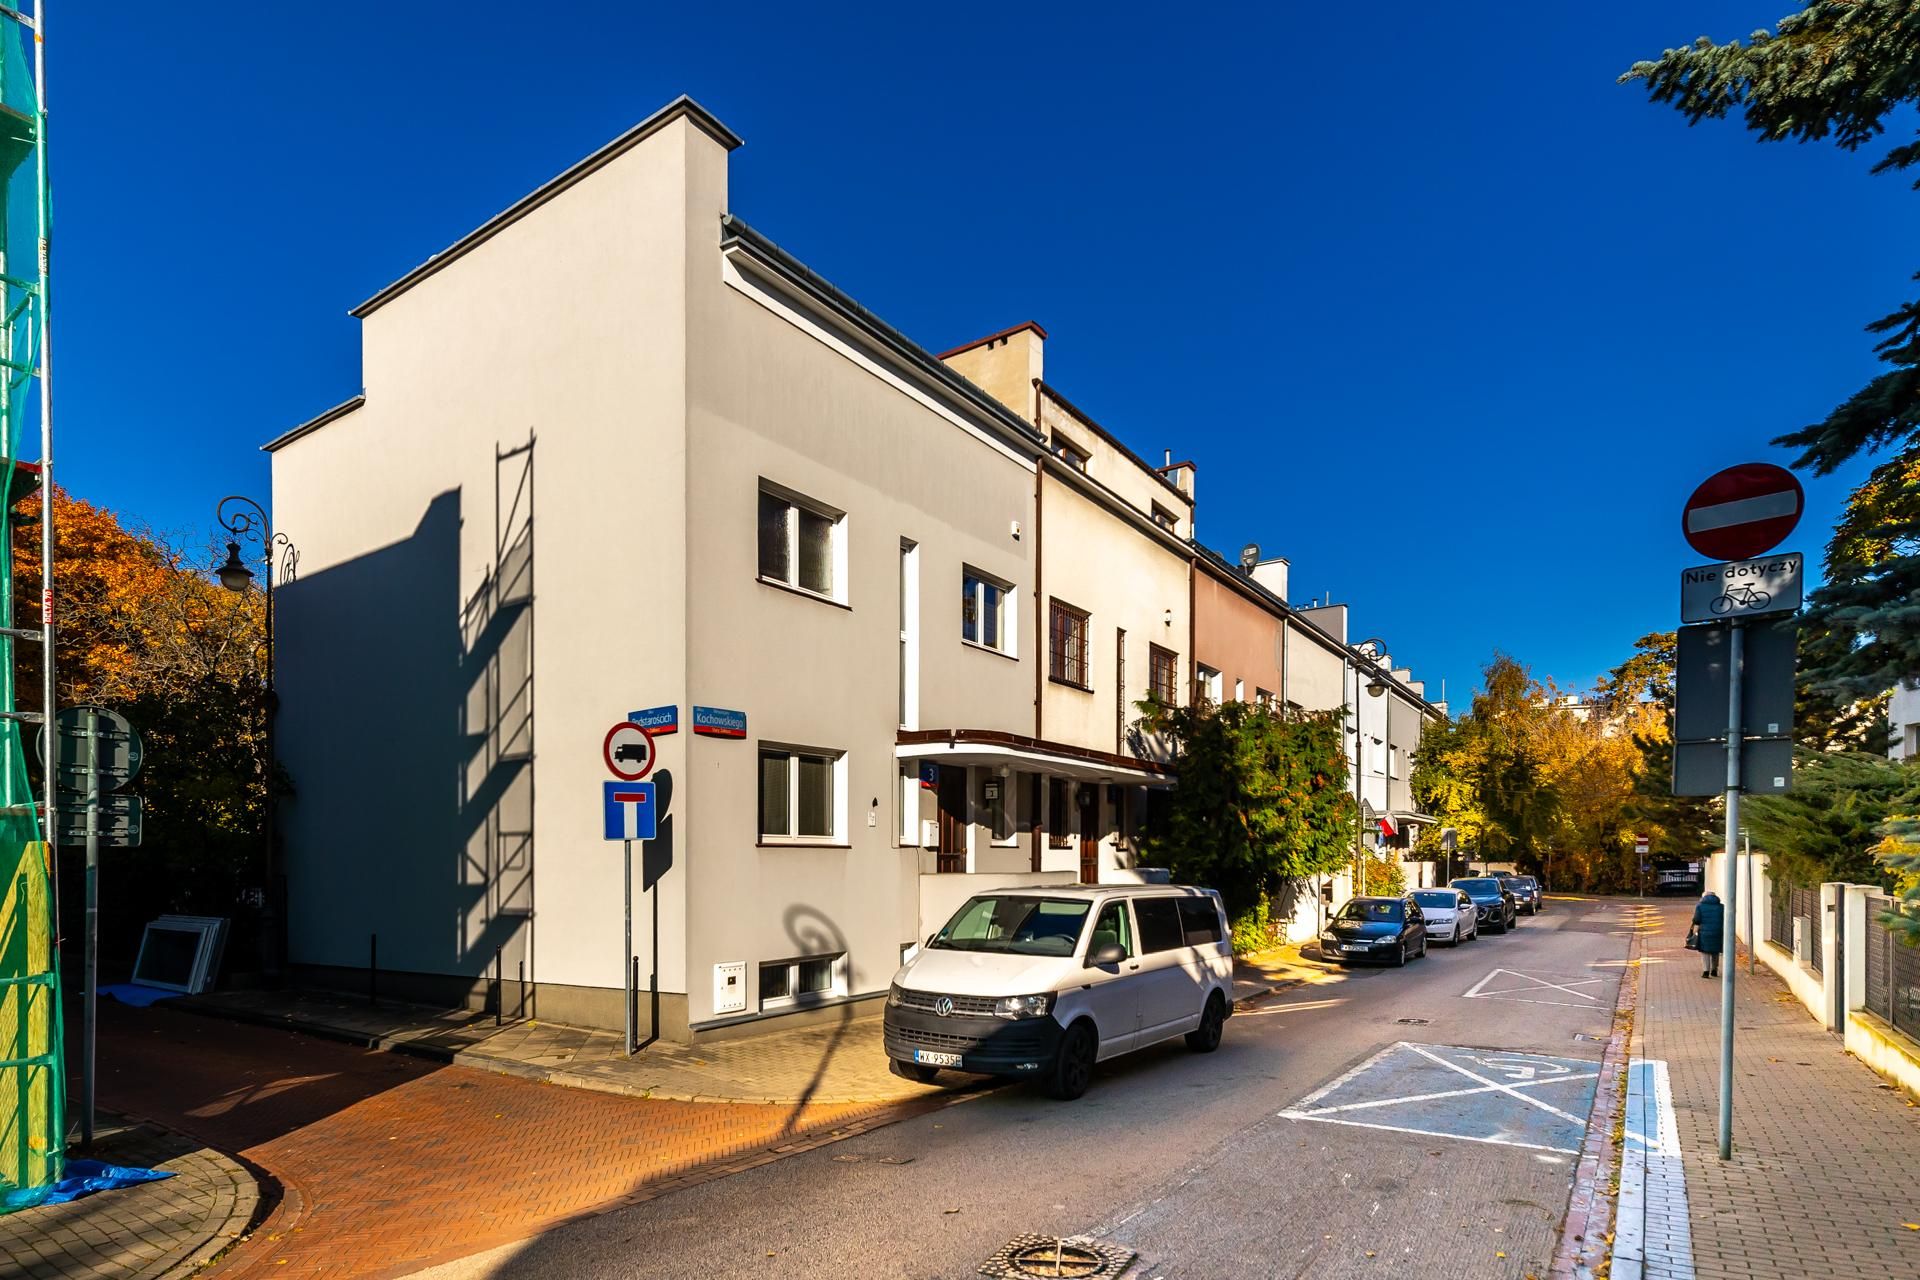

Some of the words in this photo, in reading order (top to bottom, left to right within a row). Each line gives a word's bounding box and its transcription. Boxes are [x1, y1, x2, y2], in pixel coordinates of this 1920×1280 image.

[1686, 571, 1716, 584] Nie
[1725, 559, 1798, 579] dotyczy
[44, 602, 52, 623] DELTA
[697, 713, 743, 729] Kochowskiego
[929, 768, 934, 781] 3
